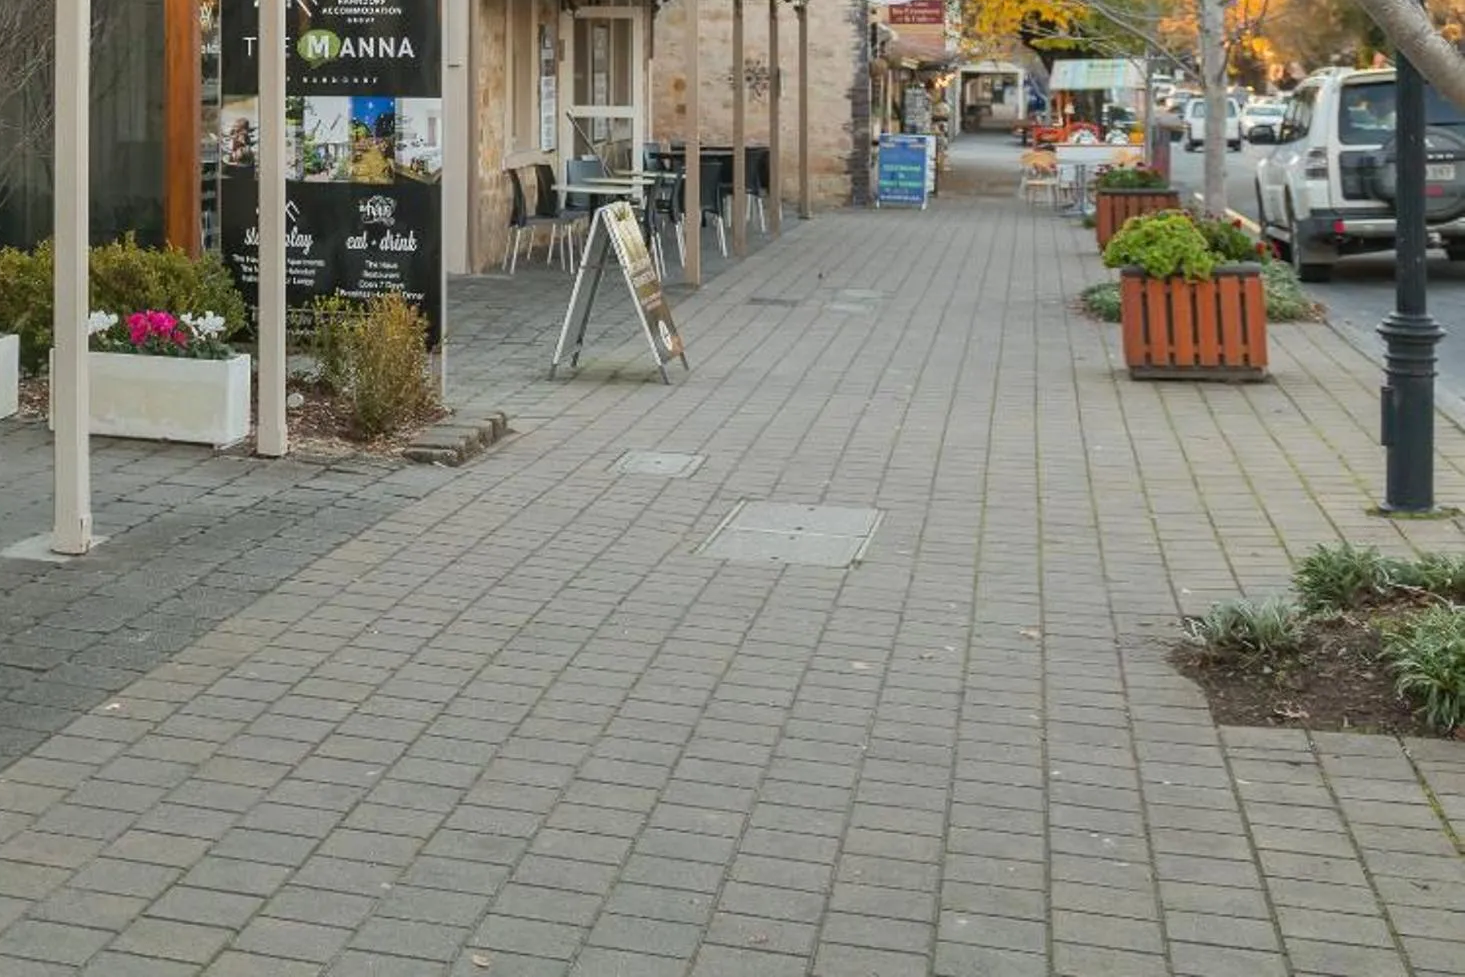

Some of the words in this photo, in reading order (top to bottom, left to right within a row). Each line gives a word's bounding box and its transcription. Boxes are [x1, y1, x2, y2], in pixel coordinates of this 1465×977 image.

[242, 37, 291, 58] TE
[307, 35, 415, 59] MANNA
[379, 229, 417, 252] drink
